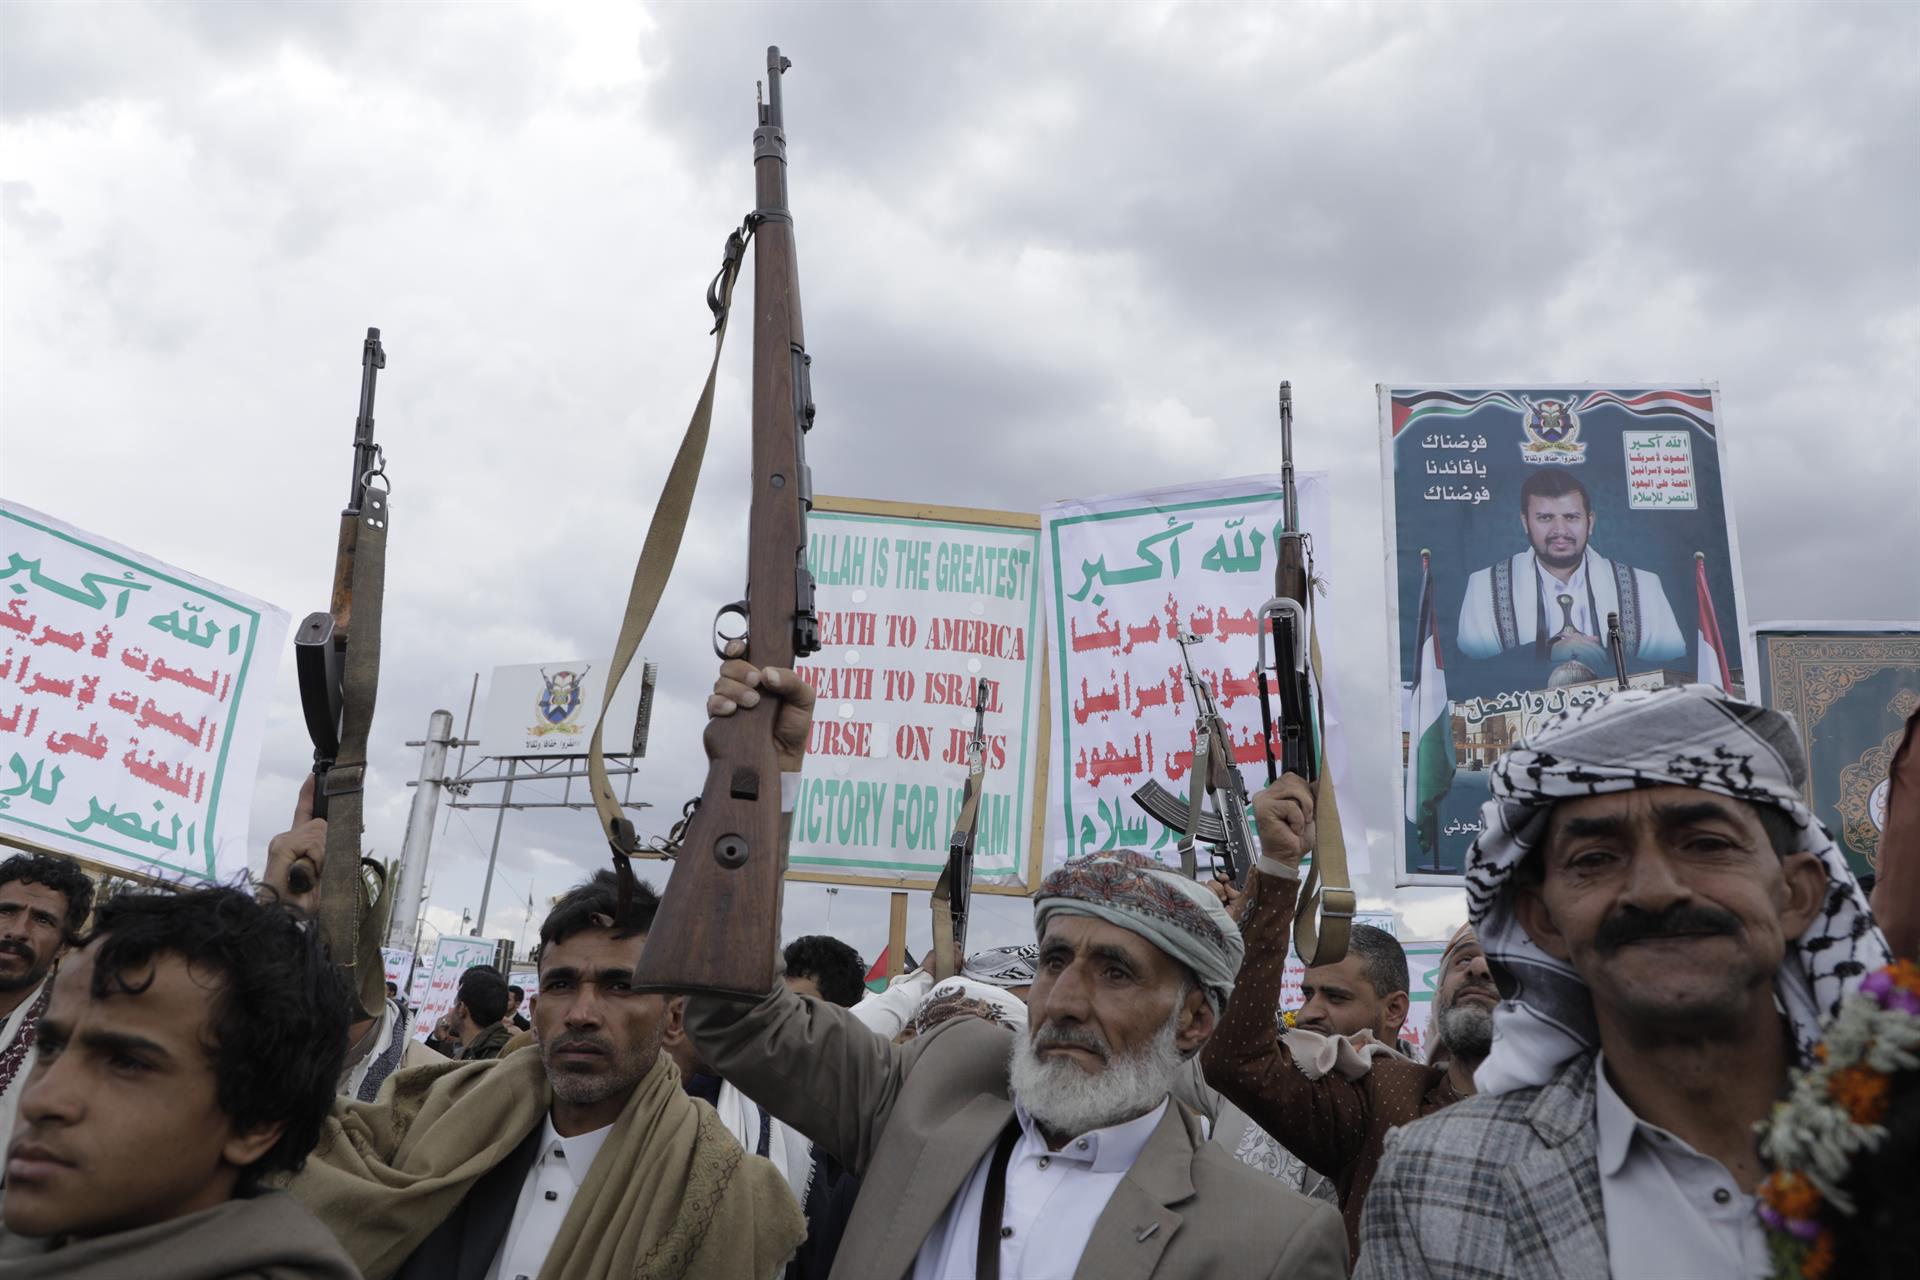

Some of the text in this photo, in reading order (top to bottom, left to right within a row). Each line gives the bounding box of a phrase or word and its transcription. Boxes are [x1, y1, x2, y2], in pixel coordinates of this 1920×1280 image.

[1421, 434, 1488, 453] فوضناك
[1629, 434, 1687, 450] الله أكبر
[1423, 485, 1490, 505] فوضناك
[1666, 490, 1693, 505] النصر
[808, 533, 1031, 601] ALLAH IS THE GREATEST
[1067, 516, 1285, 607] الله أكبر
[0, 599, 230, 702] الموت لأمريك
[148, 601, 240, 655] الله
[816, 611, 1026, 661] EATH TO AMERICA
[883, 669, 915, 702] TO
[46, 721, 108, 760] على
[109, 690, 217, 753] الموت
[806, 720, 873, 758] URSE
[895, 724, 934, 764] ON
[122, 736, 206, 804] اللعنة
[1075, 729, 1154, 788] اليهود
[66, 795, 196, 855] النصر
[891, 783, 939, 851] FOR
[944, 787, 1011, 856] ISAM
[1443, 817, 1482, 836] لحوثي
